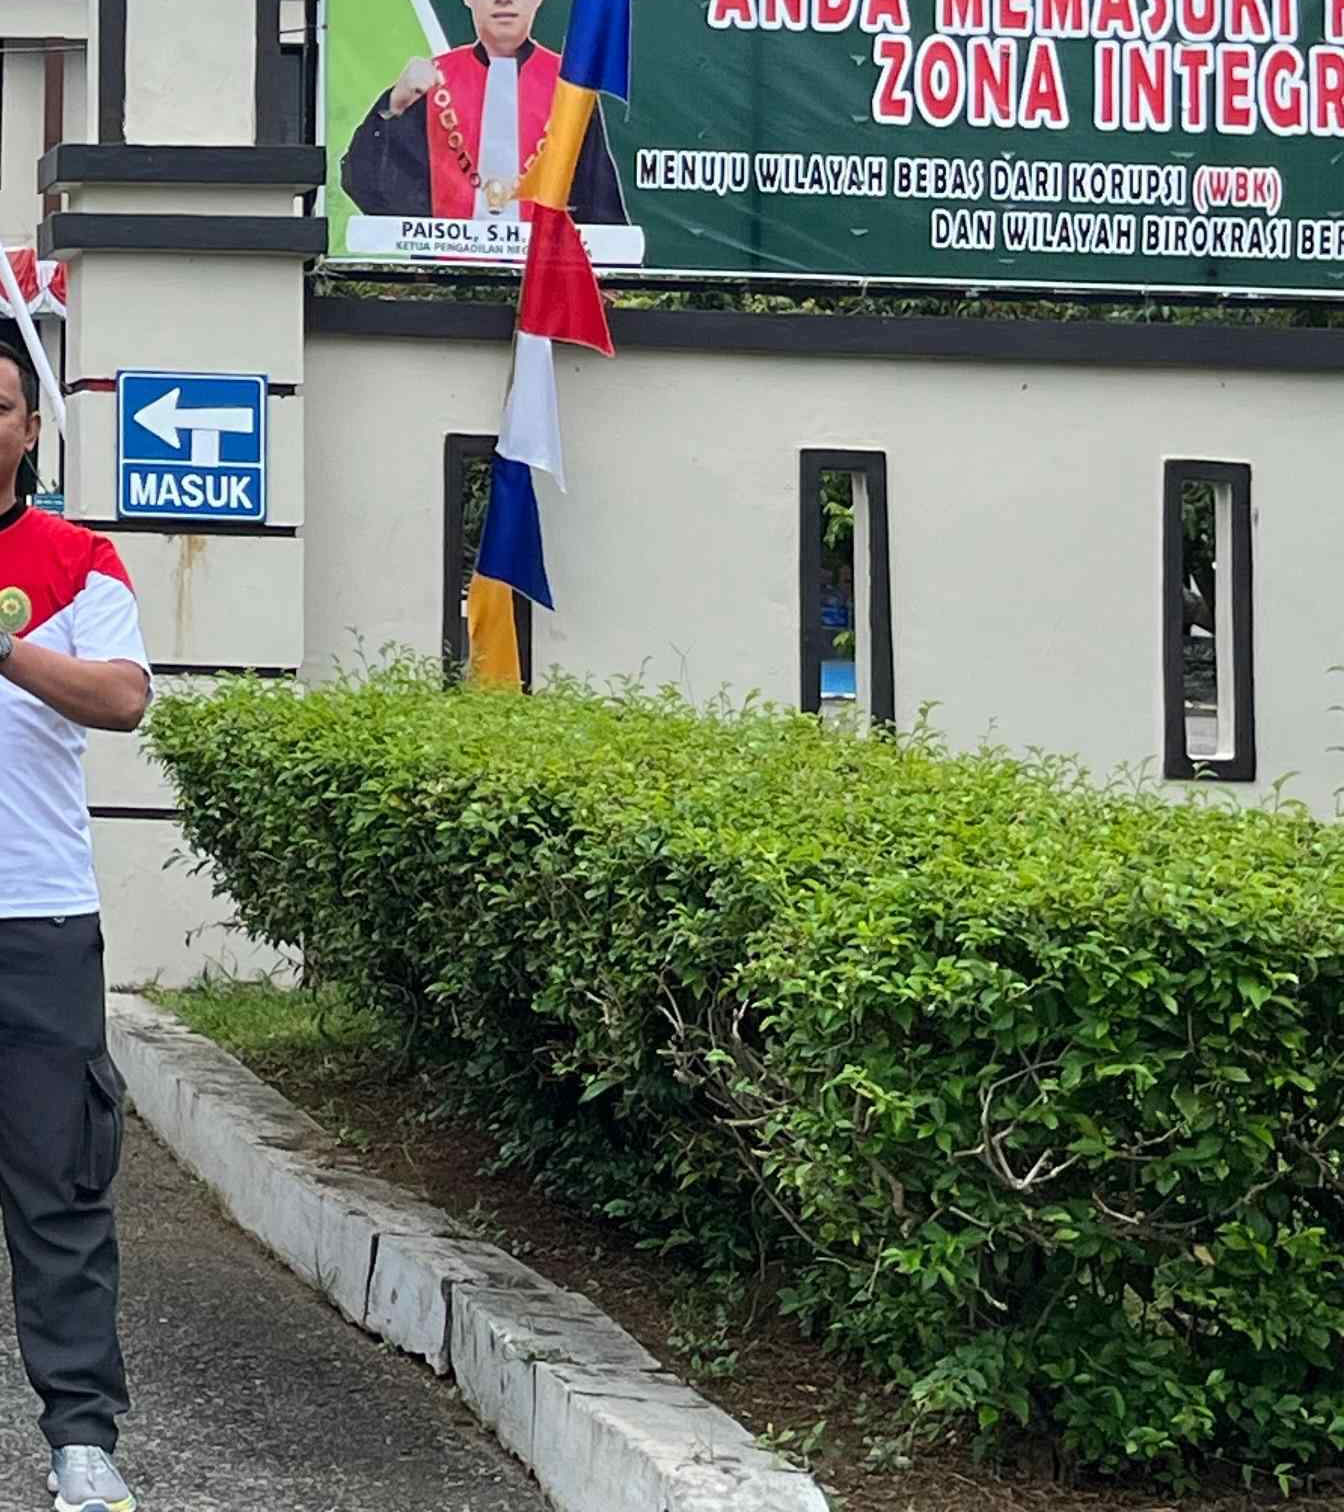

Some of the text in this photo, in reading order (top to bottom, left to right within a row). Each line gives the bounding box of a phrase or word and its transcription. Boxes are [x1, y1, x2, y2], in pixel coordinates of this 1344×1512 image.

[873, 34, 1344, 137] ZONA INTEGR
[636, 149, 1284, 214] MENUJU WILAYAH BEBAS DARI KORUPSI (WBK)
[395, 241, 431, 252] KETUA
[433, 242, 505, 255] PENGADILAN
[401, 221, 480, 243] PAISOL,
[931, 208, 995, 249] DAN
[1002, 211, 1136, 254] WILAYAH
[1142, 215, 1291, 259] BIROKRASI
[129, 472, 254, 509] MASUK
